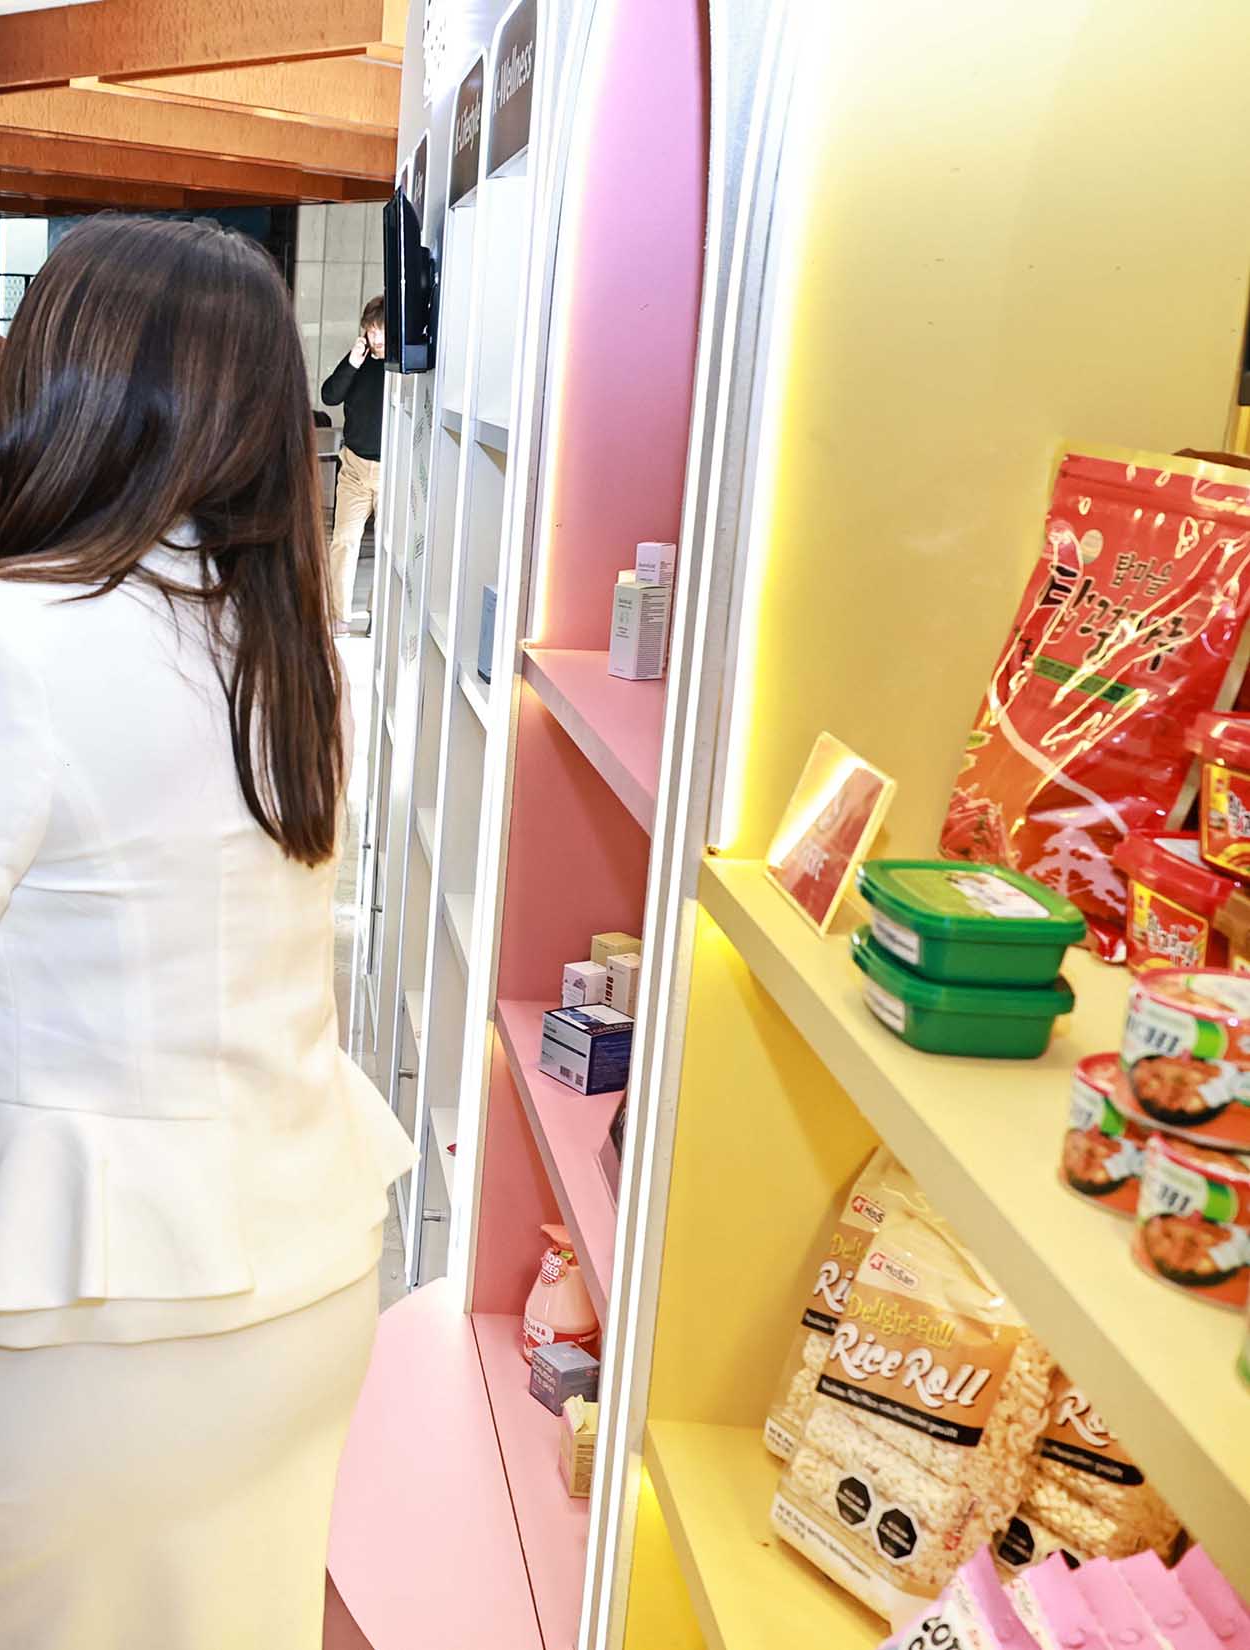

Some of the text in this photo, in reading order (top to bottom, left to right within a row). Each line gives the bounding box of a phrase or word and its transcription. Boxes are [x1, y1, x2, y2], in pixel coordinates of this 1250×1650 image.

[454, 92, 481, 155] K-Lifestyle
[813, 1261, 854, 1313] Ri
[829, 1322, 903, 1381] Rice
[902, 1347, 993, 1409] Roll
